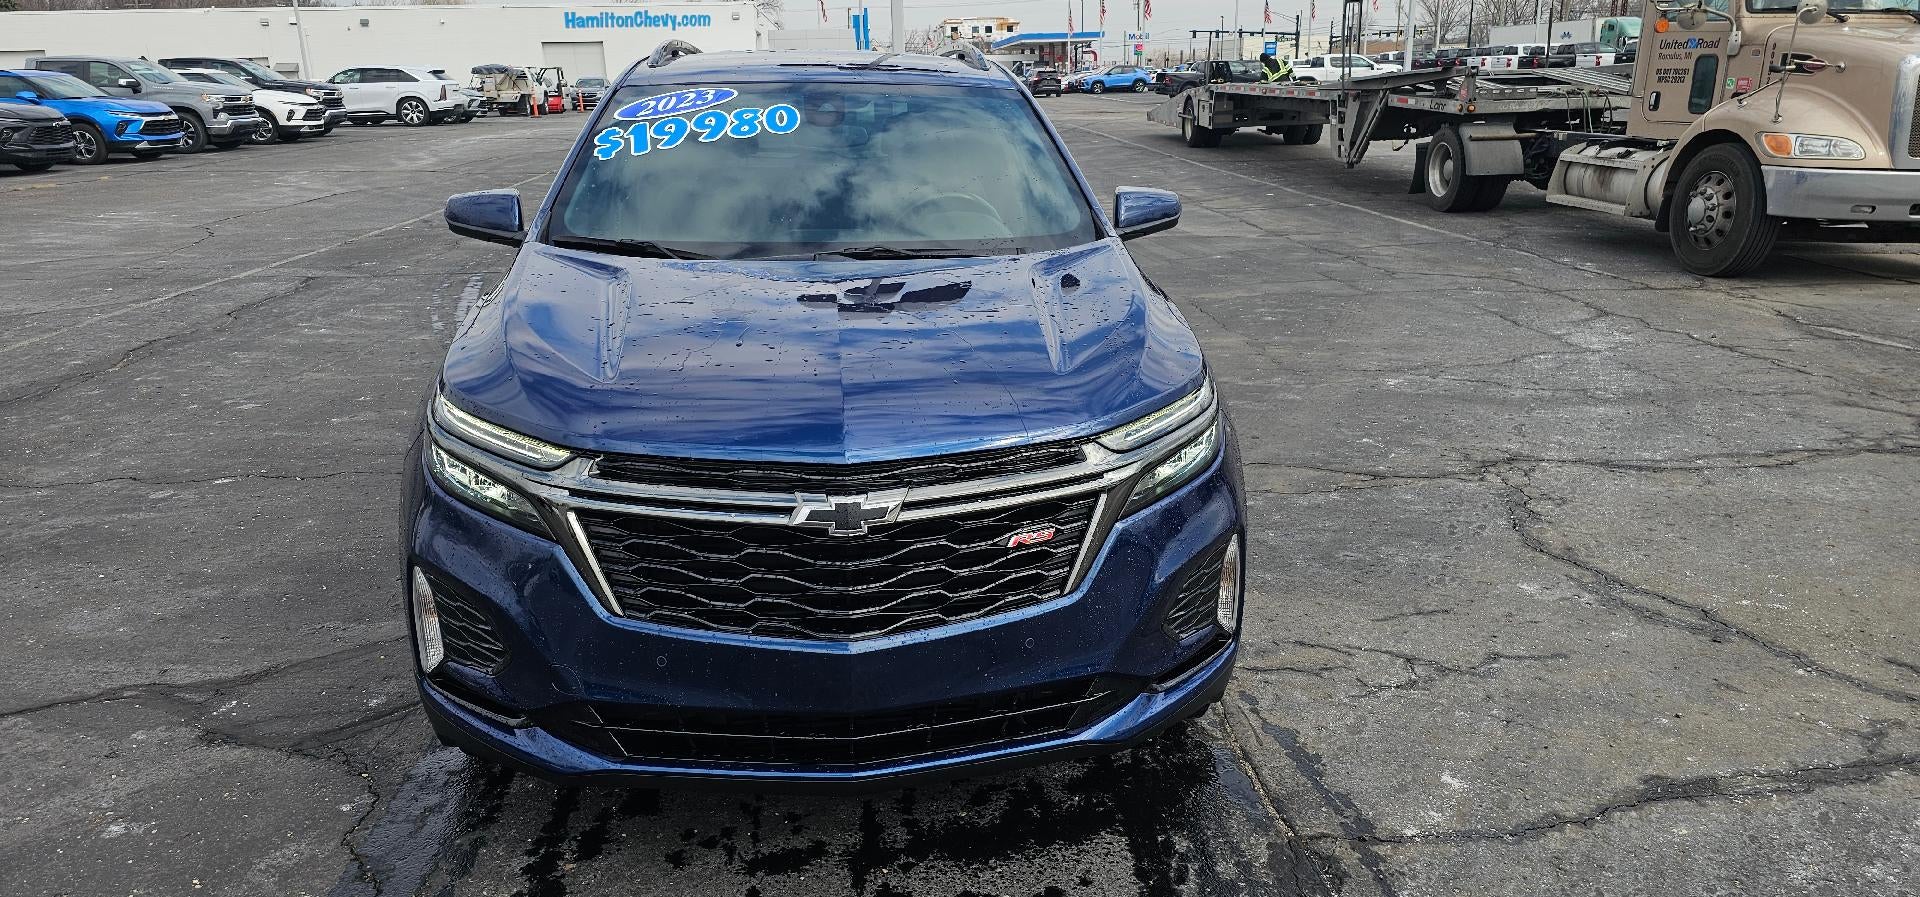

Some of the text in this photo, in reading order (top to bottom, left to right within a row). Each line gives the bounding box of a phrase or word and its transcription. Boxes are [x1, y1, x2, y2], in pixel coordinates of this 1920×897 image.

[564, 10, 711, 31] HamiltonChevy.com
[1128, 32, 1150, 41] Mobil
[1659, 37, 1721, 50] United Road
[636, 89, 717, 117] 2023
[594, 104, 801, 160] $19980
[1006, 526, 1056, 548] RS
